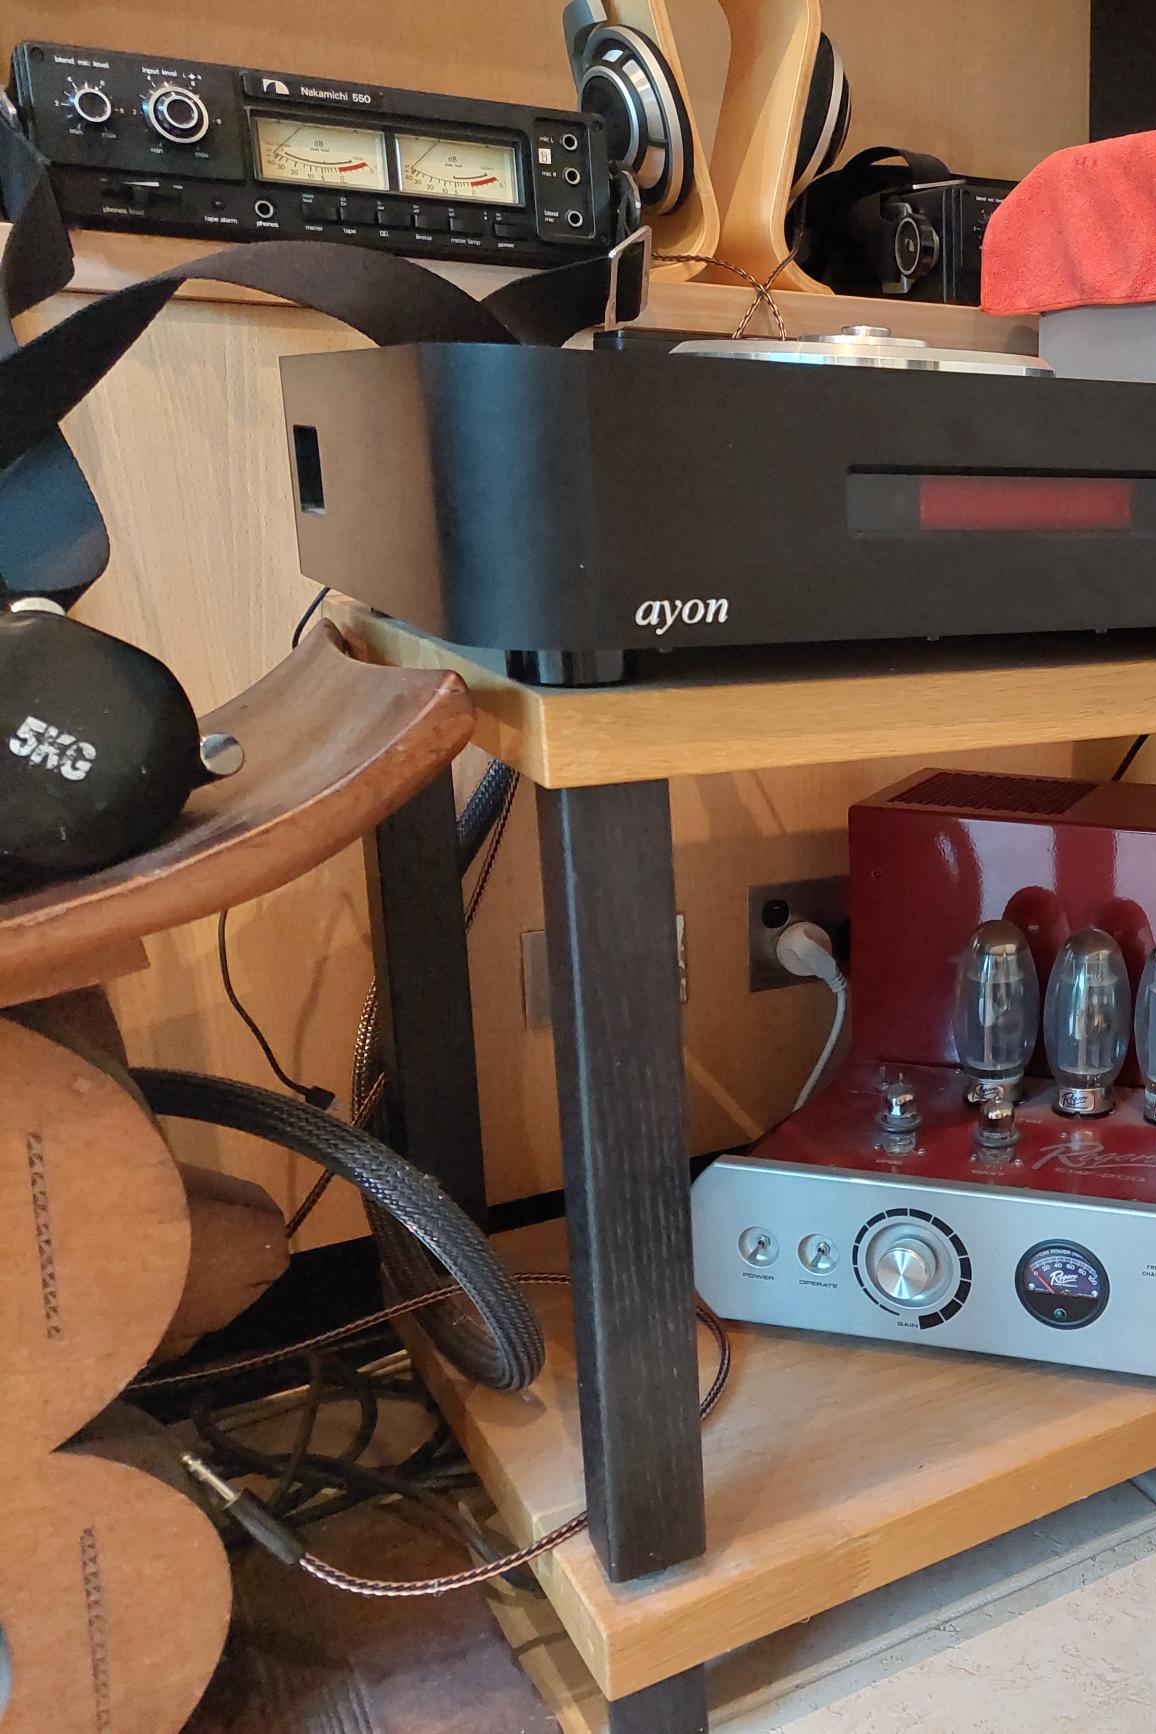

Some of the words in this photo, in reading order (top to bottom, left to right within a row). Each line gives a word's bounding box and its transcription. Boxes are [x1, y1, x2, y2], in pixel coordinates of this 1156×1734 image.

[300, 86, 349, 102] Nakamichi
[352, 93, 372, 105] 550
[543, 209, 560, 218] blend
[635, 598, 729, 636] ayon
[9, 715, 97, 781] 5KG
[742, 1272, 775, 1281] POWER
[1041, 1264, 1051, 1272] 20
[1077, 1268, 1087, 1276] 80
[1087, 1274, 1098, 1286] 100
[1049, 1270, 1079, 1286] Rogers
[798, 1279, 838, 1289] OPERATE
[896, 1320, 919, 1329] GAIN
